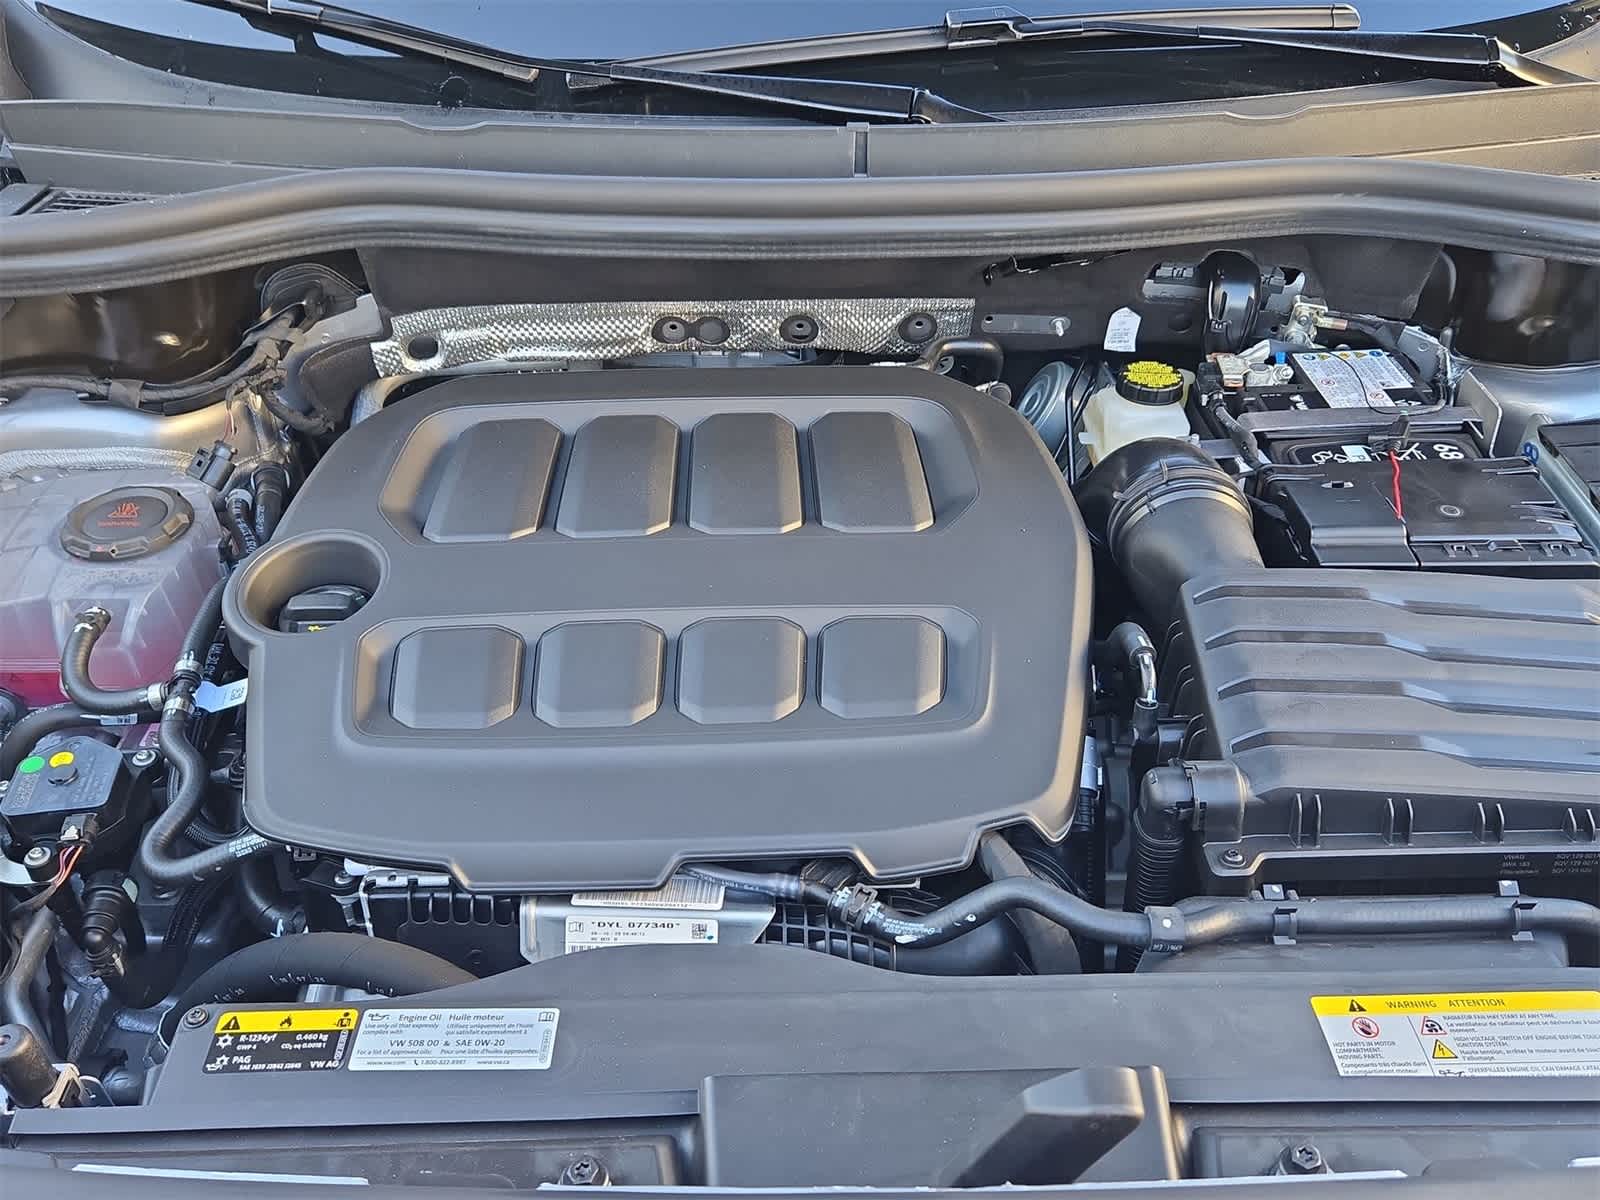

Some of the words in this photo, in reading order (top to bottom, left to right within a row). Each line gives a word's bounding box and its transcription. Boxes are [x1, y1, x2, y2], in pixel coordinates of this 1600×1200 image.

[1385, 999, 1437, 1009] WARNING
[1448, 997, 1506, 1008] ATTENTION
[398, 1013, 428, 1023] Engine
[429, 1013, 442, 1021] Oil
[449, 1013, 472, 1021] Huile
[239, 1033, 278, 1044] R-1234yf
[318, 1033, 329, 1042] kg
[390, 1039, 407, 1047] VW
[408, 1039, 425, 1047] 508
[426, 1039, 440, 1047] 00
[455, 1039, 473, 1047] SAE
[475, 1039, 505, 1047] 0W-20
[231, 1055, 252, 1065] PAG
[309, 1060, 325, 1068] VW
[325, 1060, 339, 1068] AG
